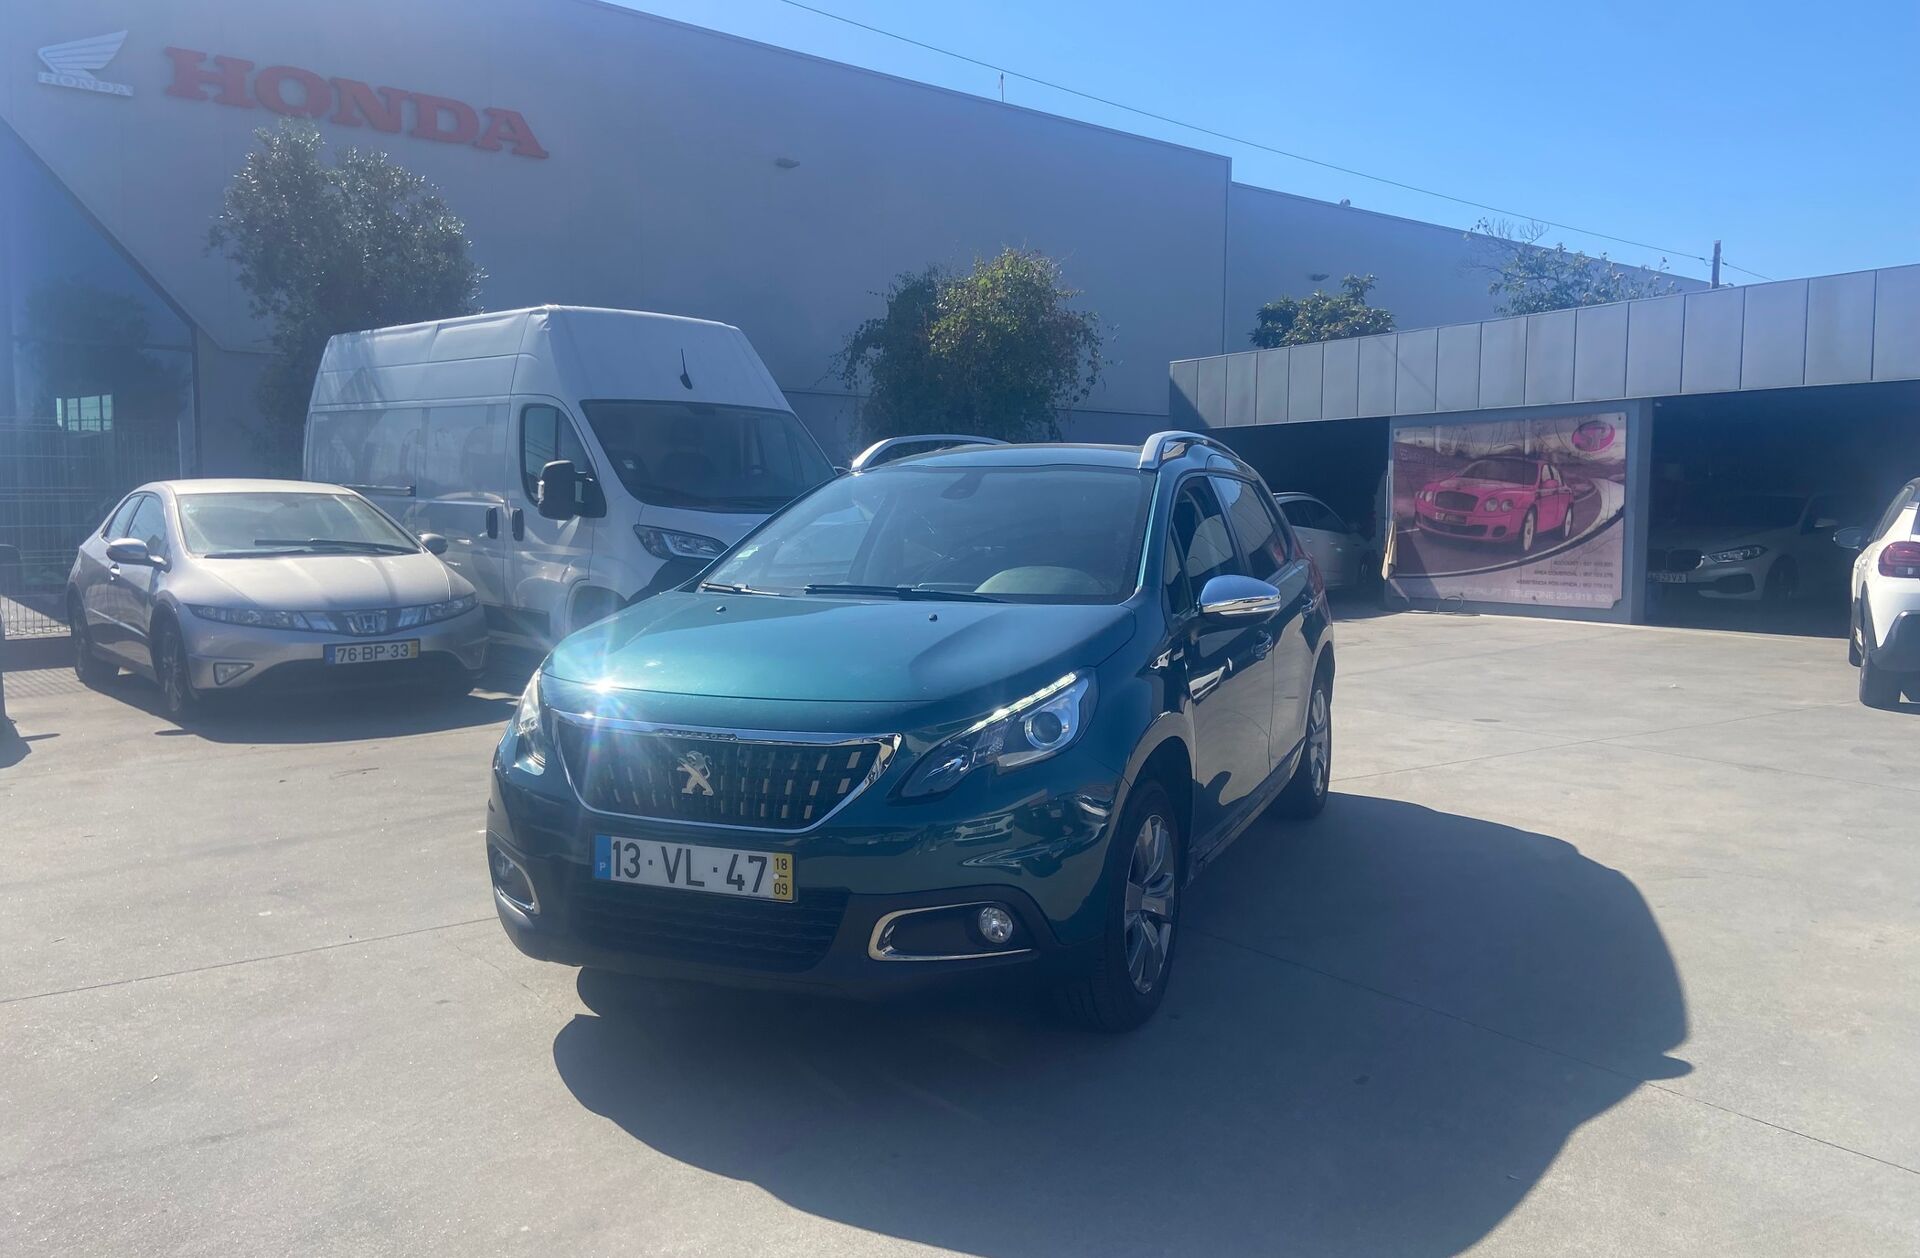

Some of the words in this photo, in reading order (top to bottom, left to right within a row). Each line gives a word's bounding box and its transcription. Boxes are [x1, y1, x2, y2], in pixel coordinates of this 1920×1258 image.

[38, 72, 134, 97] HONDA
[164, 46, 549, 159] HONDA
[775, 857, 788, 871] 18
[774, 882, 788, 896] 09
